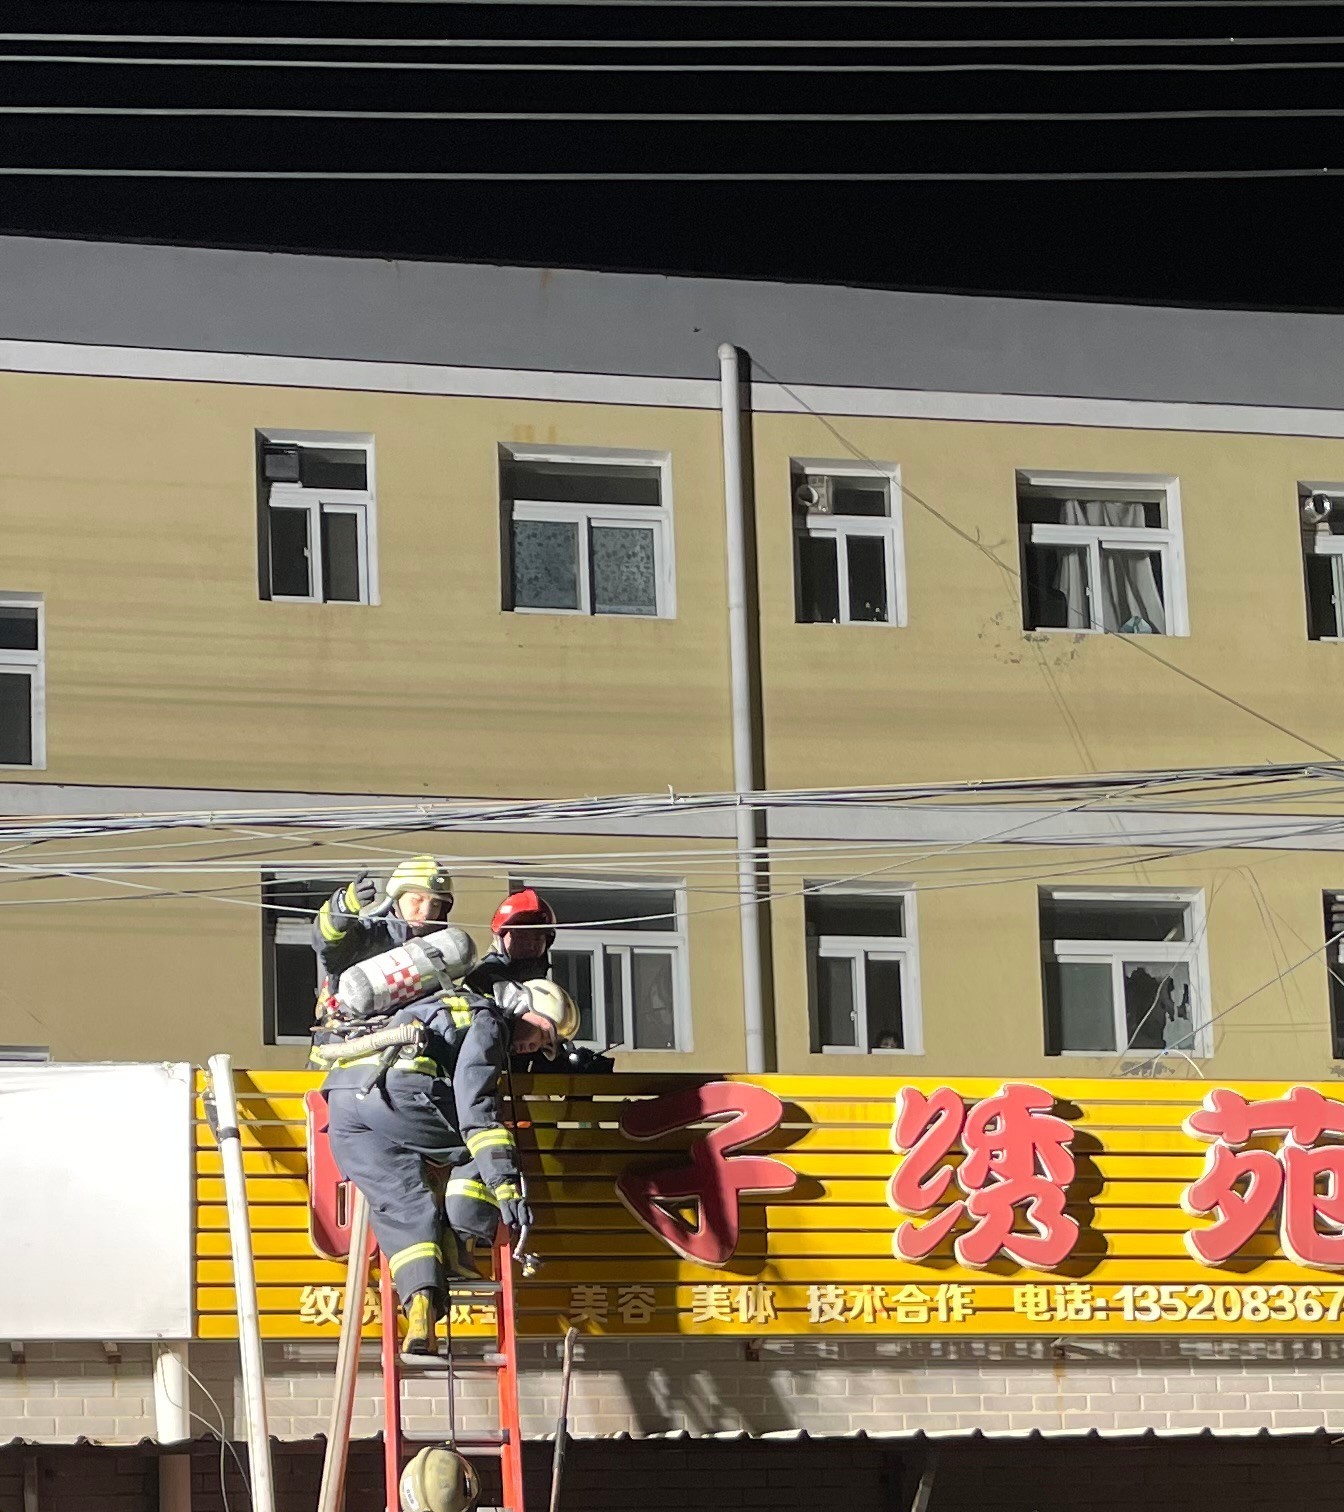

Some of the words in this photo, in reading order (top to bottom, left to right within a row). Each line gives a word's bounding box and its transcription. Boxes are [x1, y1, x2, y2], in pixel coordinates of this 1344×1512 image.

[569, 1283, 657, 1324] 美容
[690, 1283, 778, 1323] 美体
[806, 1283, 974, 1323] 技术合作
